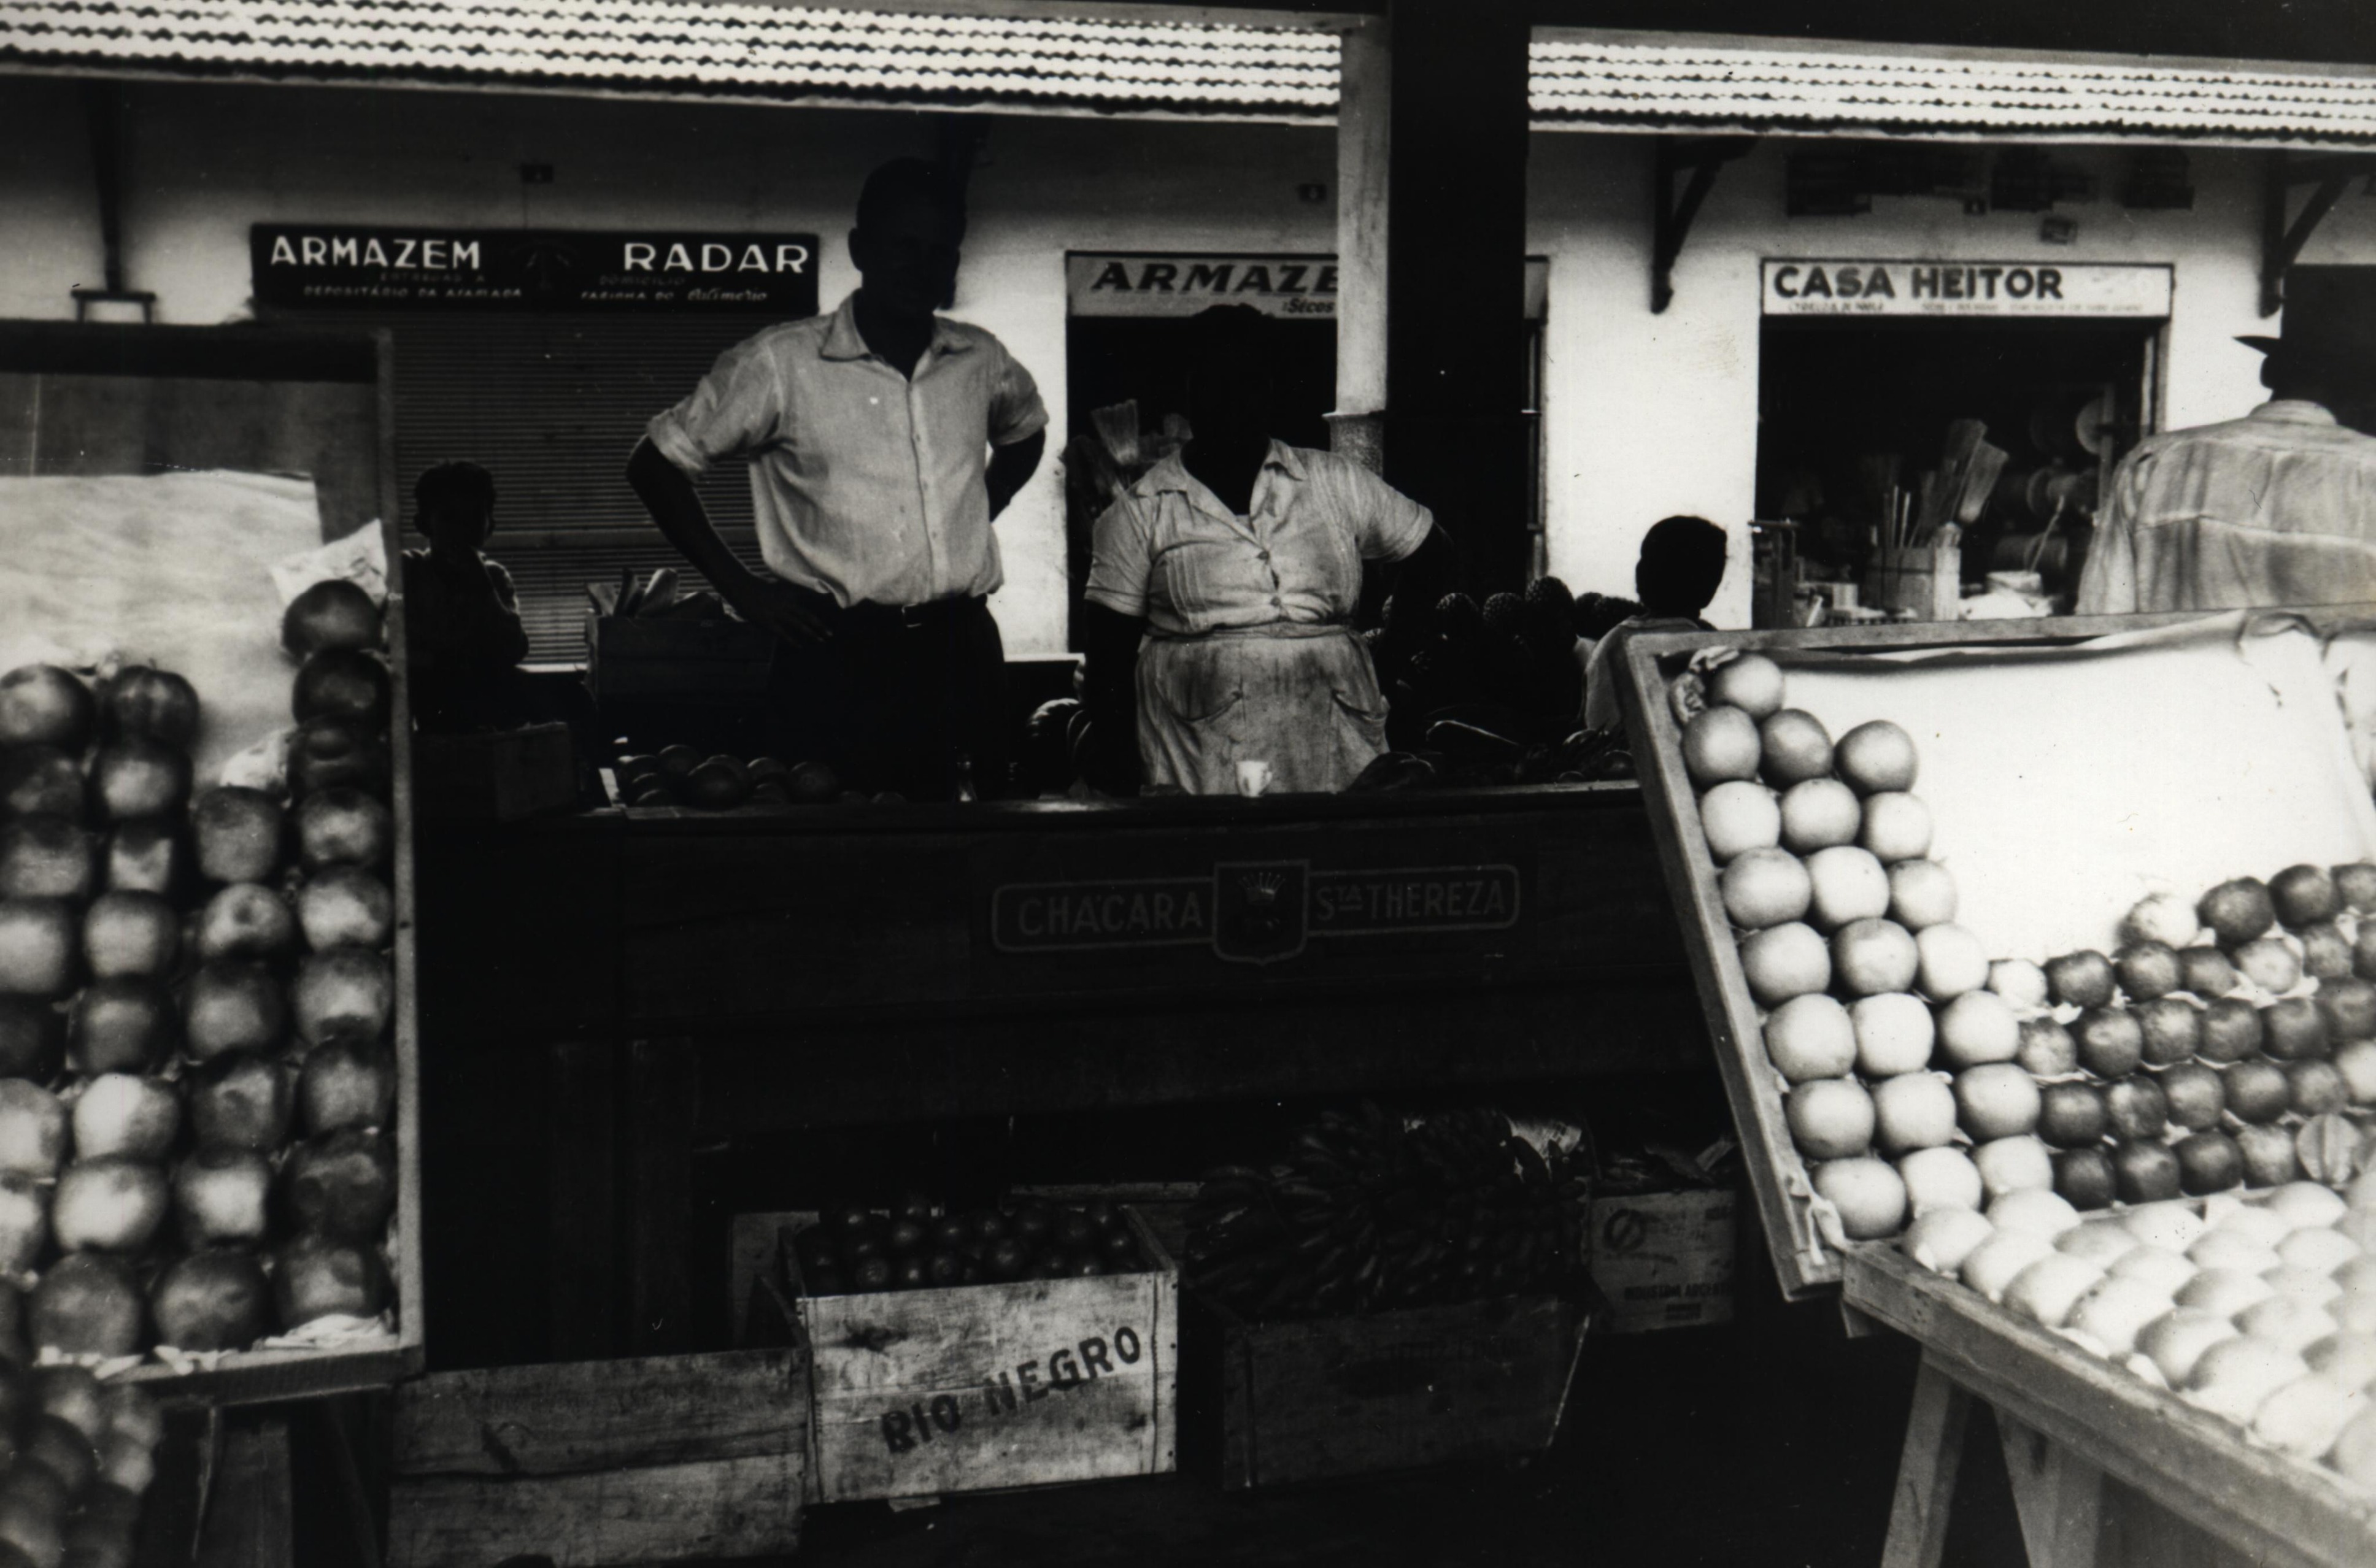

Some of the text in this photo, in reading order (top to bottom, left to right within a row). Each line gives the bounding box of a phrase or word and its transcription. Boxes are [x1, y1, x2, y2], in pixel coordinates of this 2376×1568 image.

[271, 236, 808, 274] ARMAZEM RADAR
[1773, 266, 2064, 299] CASA HEITOR
[1367, 878, 1507, 921] THEREZA
[881, 1326, 1141, 1454] RIO NEGRO
